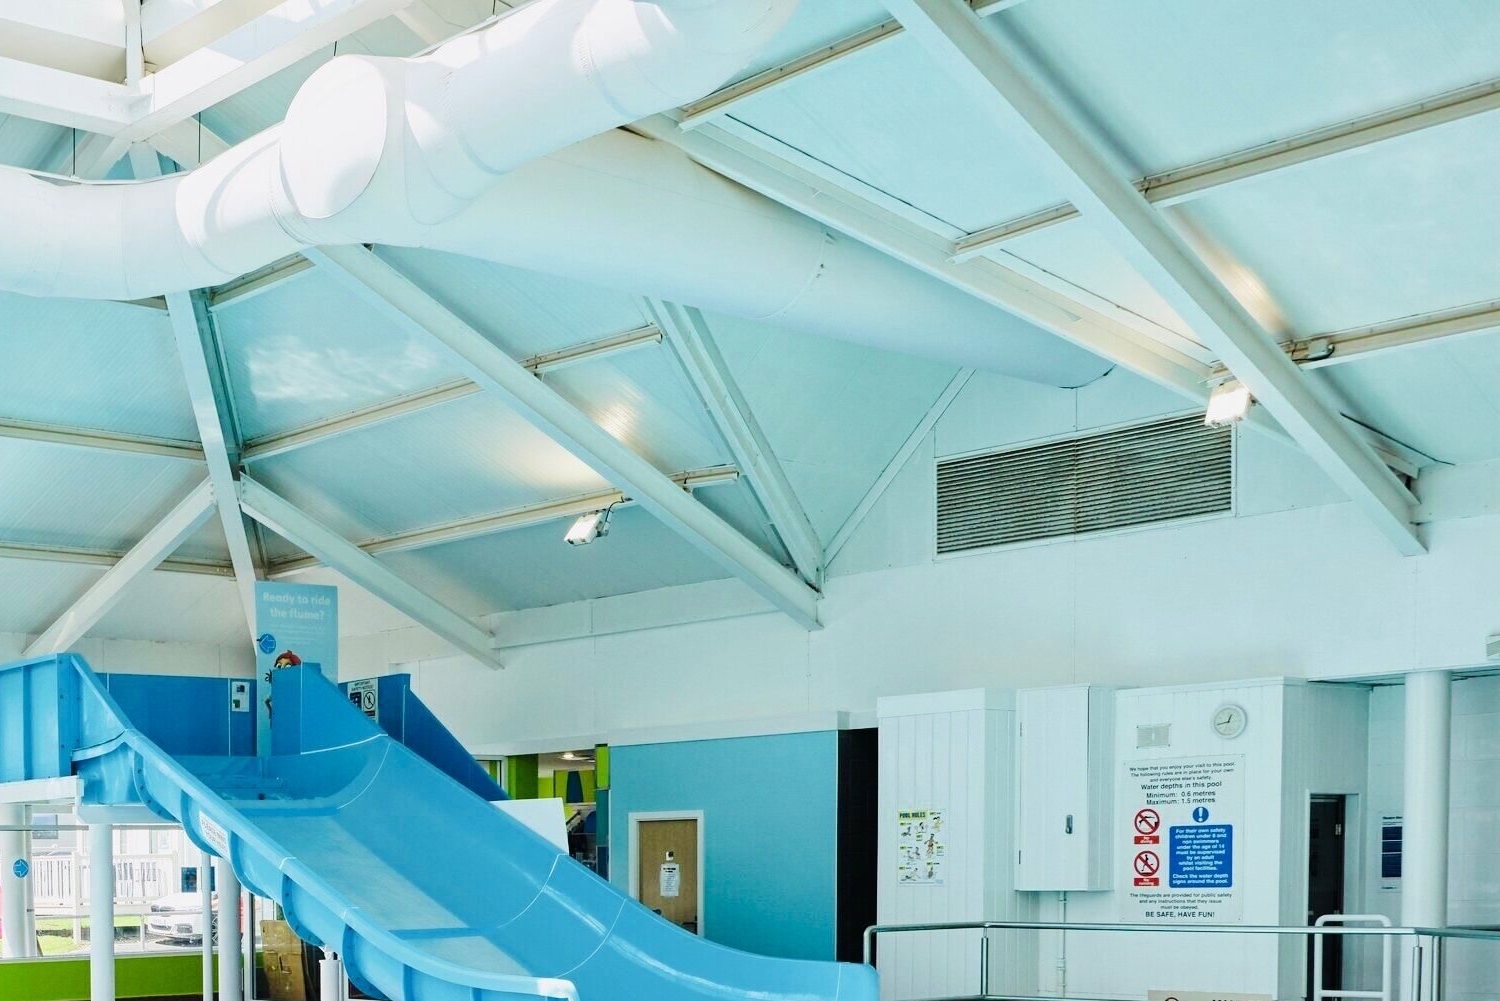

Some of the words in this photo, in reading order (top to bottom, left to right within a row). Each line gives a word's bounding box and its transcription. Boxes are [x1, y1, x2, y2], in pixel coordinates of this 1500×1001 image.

[263, 592, 294, 605] Ready
[299, 595, 308, 604] to
[311, 595, 330, 606] ride
[270, 608, 288, 618] the
[291, 608, 324, 620] flume?
